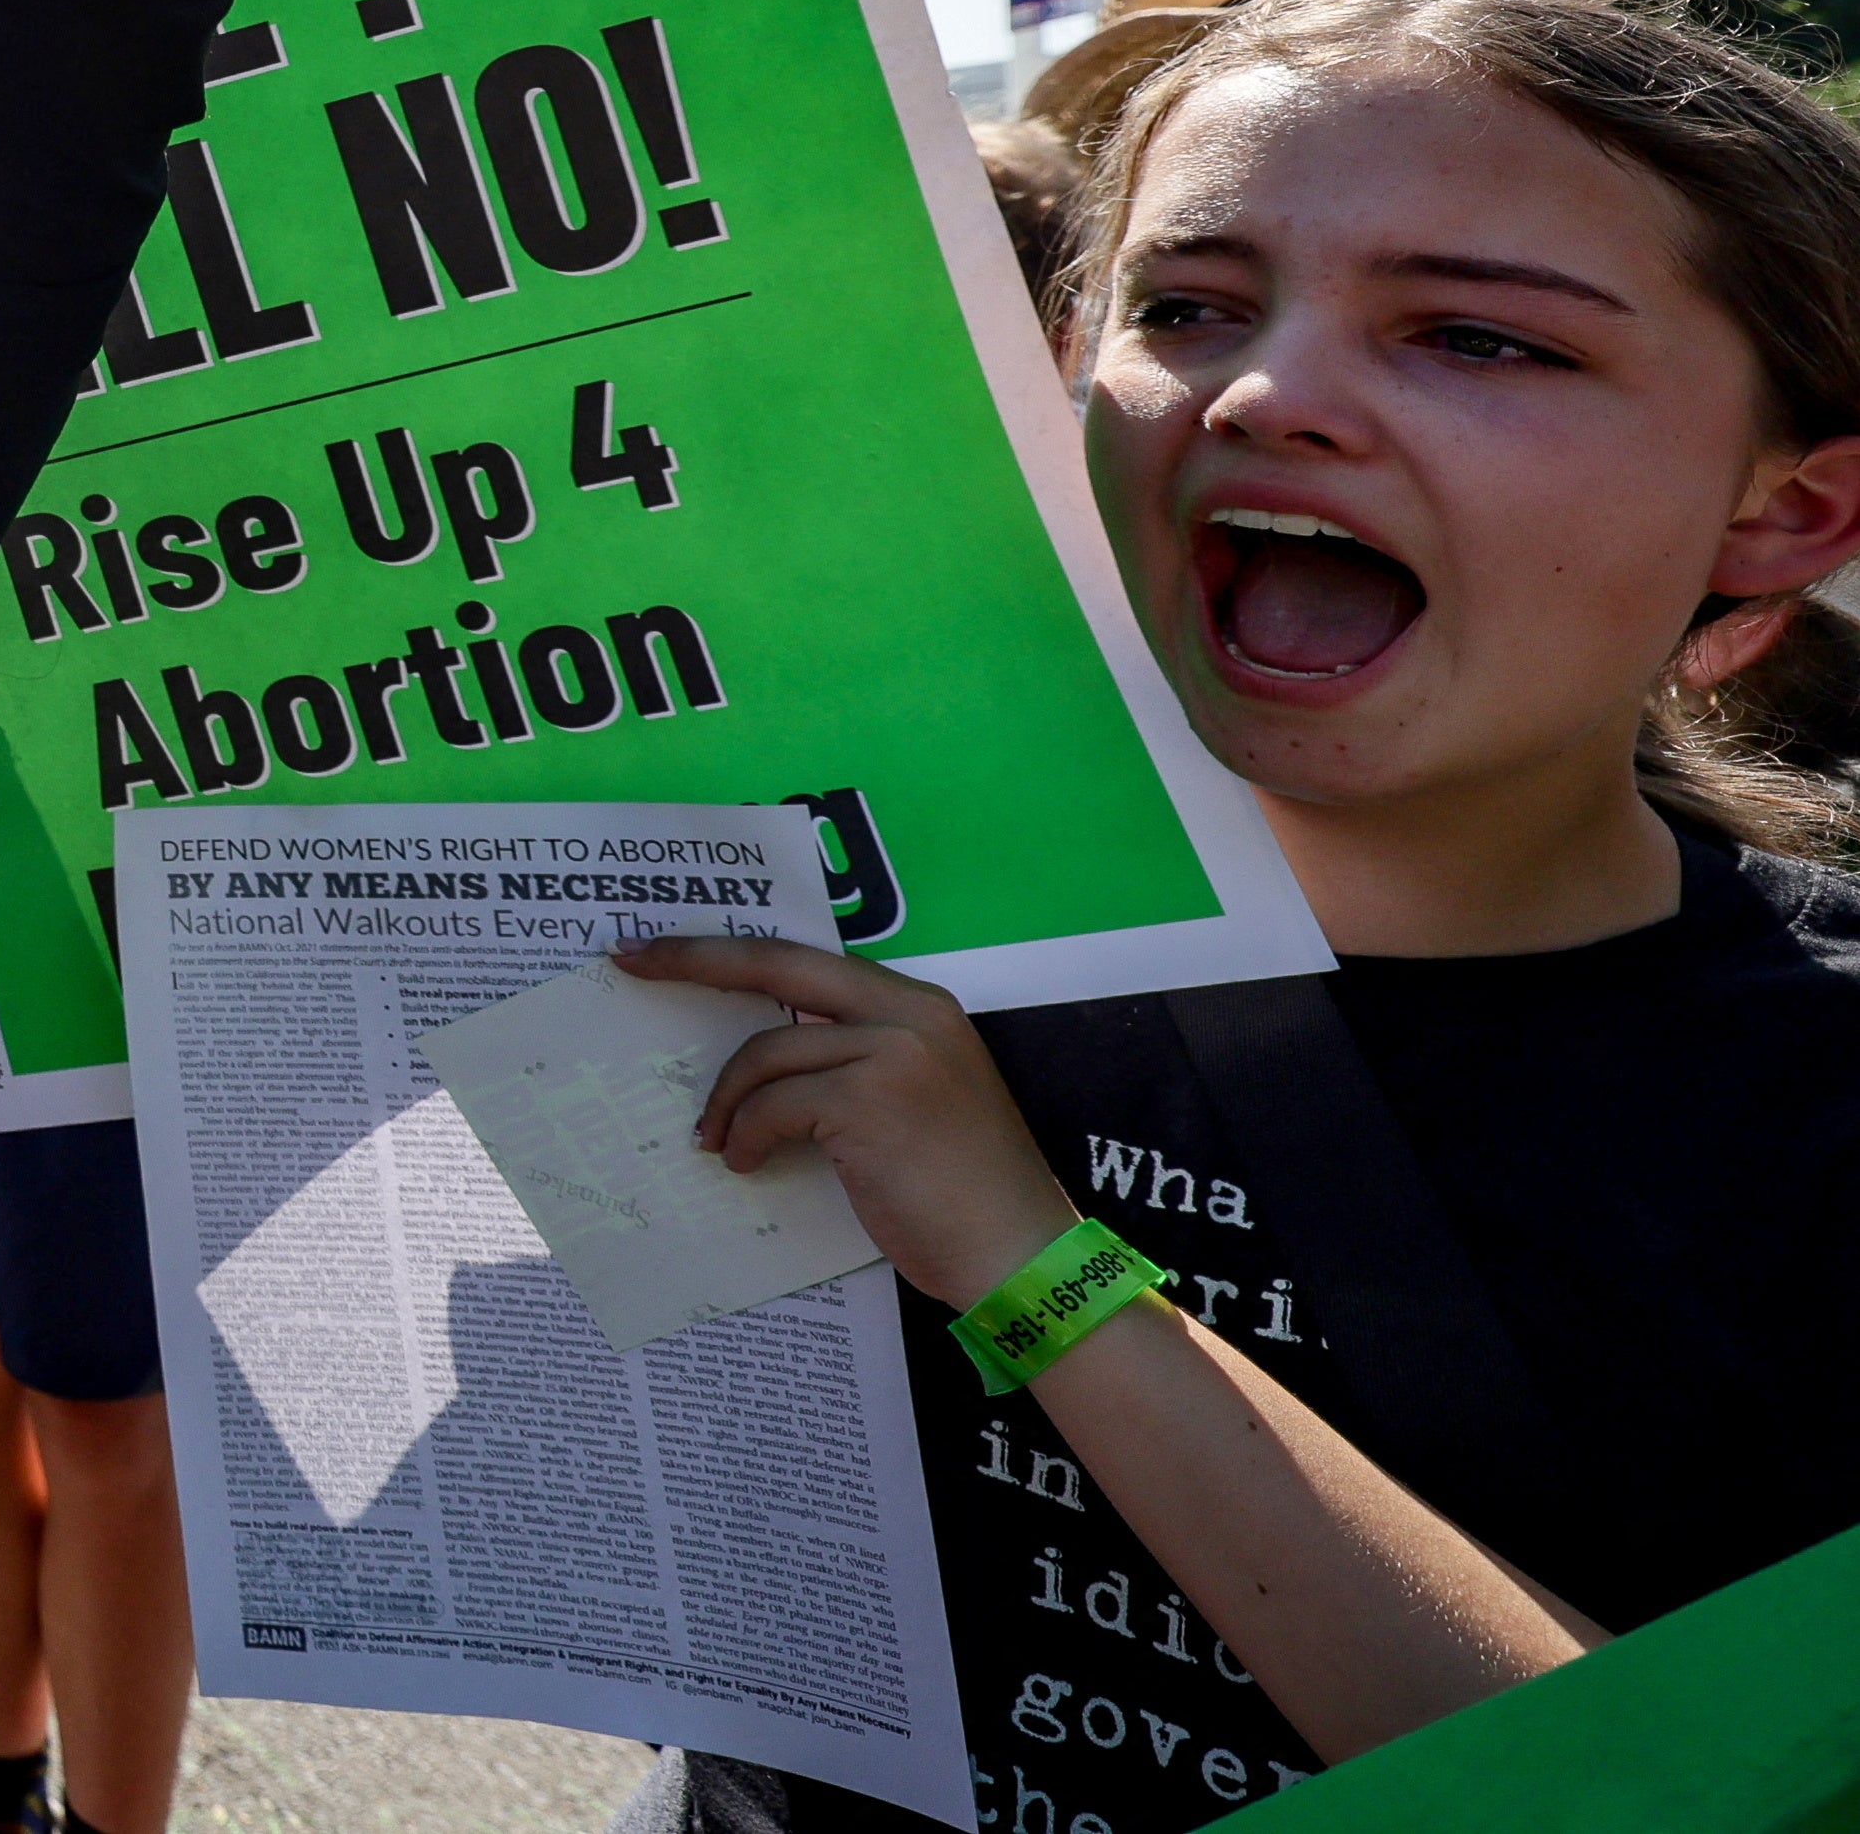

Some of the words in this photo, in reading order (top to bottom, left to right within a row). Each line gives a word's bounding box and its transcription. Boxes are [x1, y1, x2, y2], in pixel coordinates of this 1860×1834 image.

[324, 16, 730, 321] NO!
[322, 426, 536, 585] Up
[567, 378, 681, 513] 4
[91, 599, 729, 813] Abortion
[160, 837, 272, 864] DEFEND
[278, 837, 433, 863] WOMEN'S
[442, 838, 539, 863] RIGHT
[542, 839, 591, 863] TO
[597, 839, 766, 867] ABORTION
[167, 872, 213, 899] BY
[224, 872, 317, 900] ANY
[324, 872, 490, 902] MEANS
[499, 873, 775, 909] NECESSARY
[169, 907, 306, 937] National
[312, 908, 482, 939] Walkouts
[493, 910, 596, 947] Every
[991, 1244, 1137, 1360] 1-866-491-1543
[247, 1626, 304, 1649] BAMN
[368, 1633, 404, 1645] Defend
[406, 1635, 460, 1648] Affirmative
[499, 1642, 556, 1659] Integration
[567, 1651, 623, 1669] Immigrant
[665, 1667, 685, 1679] and
[686, 1670, 715, 1686] Fight
[716, 1675, 733, 1688] for
[735, 1680, 779, 1702] Equality
[780, 1690, 795, 1705] By
[797, 1696, 819, 1712] Any
[820, 1701, 856, 1719] Means
[858, 1710, 913, 1739] Necessary
